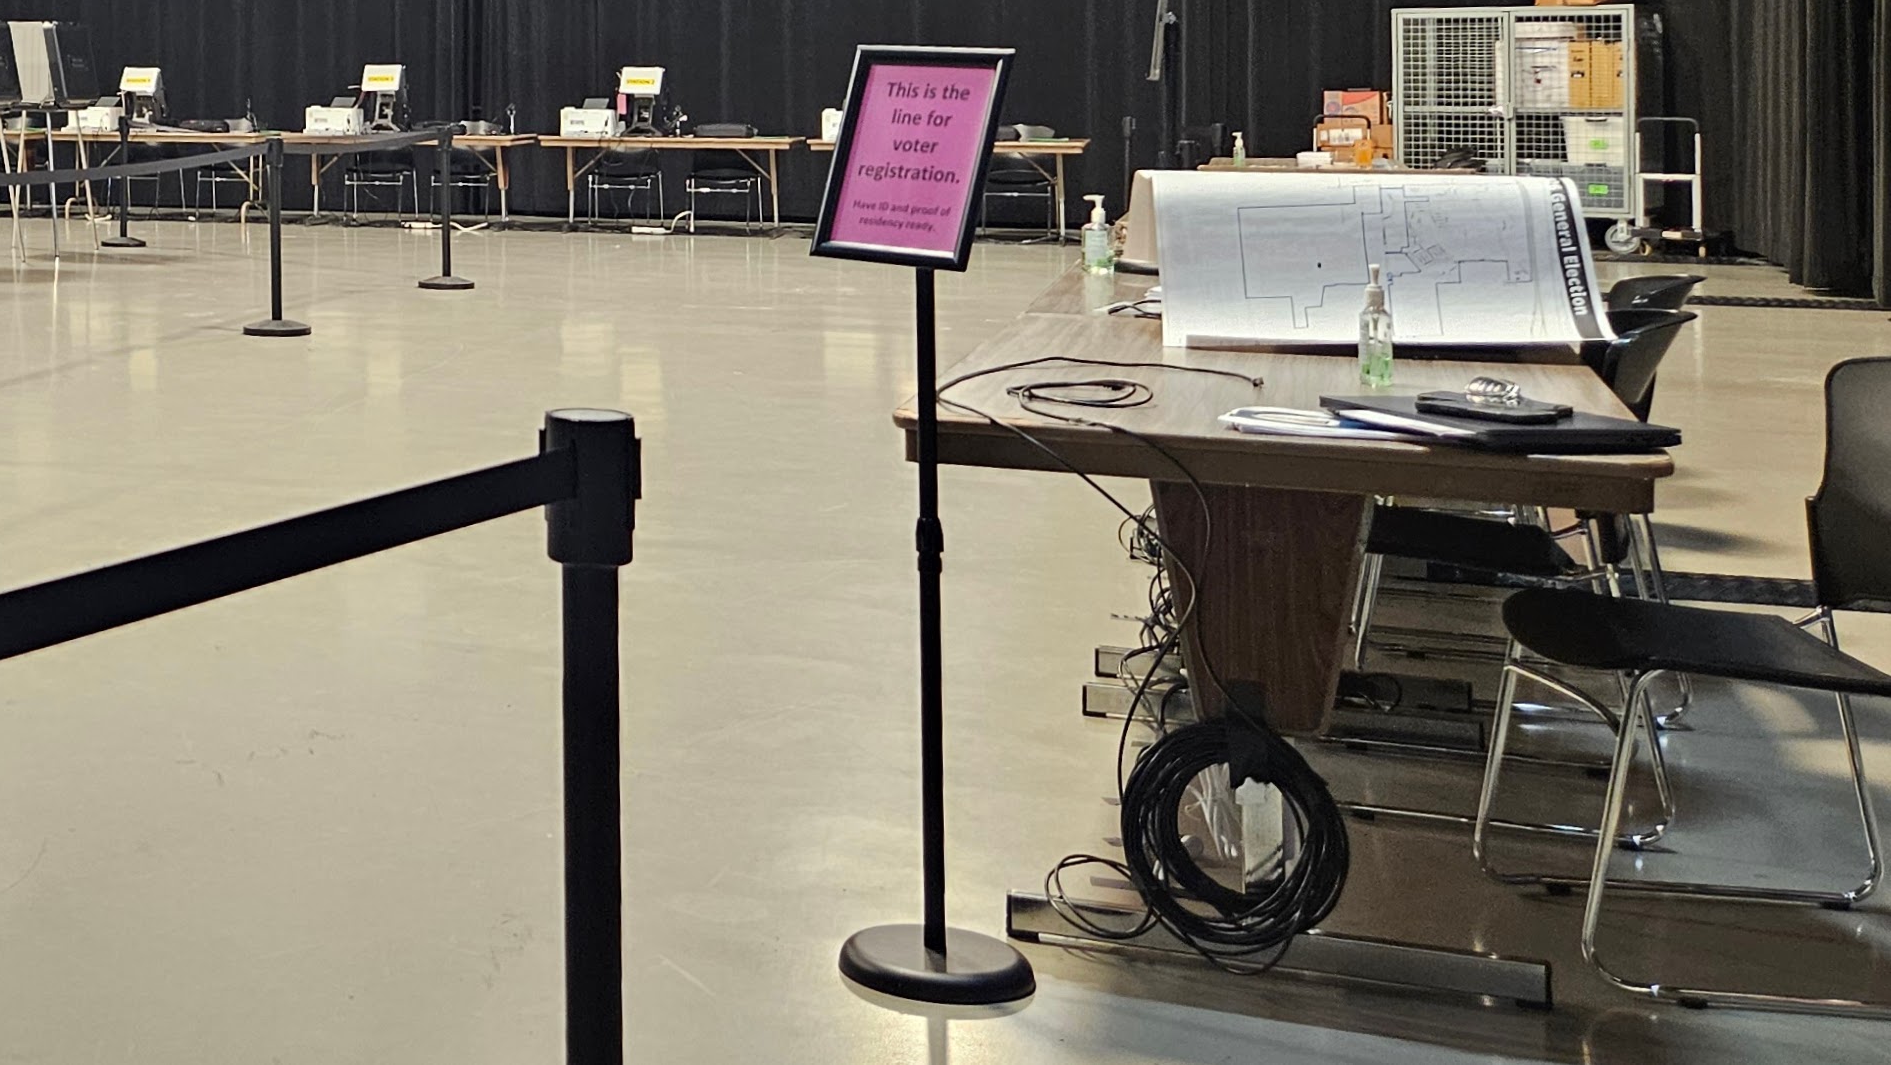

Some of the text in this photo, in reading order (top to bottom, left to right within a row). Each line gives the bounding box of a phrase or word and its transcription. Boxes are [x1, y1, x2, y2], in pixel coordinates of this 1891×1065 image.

[887, 82, 971, 101] This is the
[891, 108, 953, 127] line for
[893, 139, 939, 154] voter
[858, 162, 960, 184] registration.
[853, 200, 952, 216] Have ID and proof of
[859, 217, 904, 229] residency
[1551, 192, 1578, 252] General
[1563, 255, 1588, 316] Election
